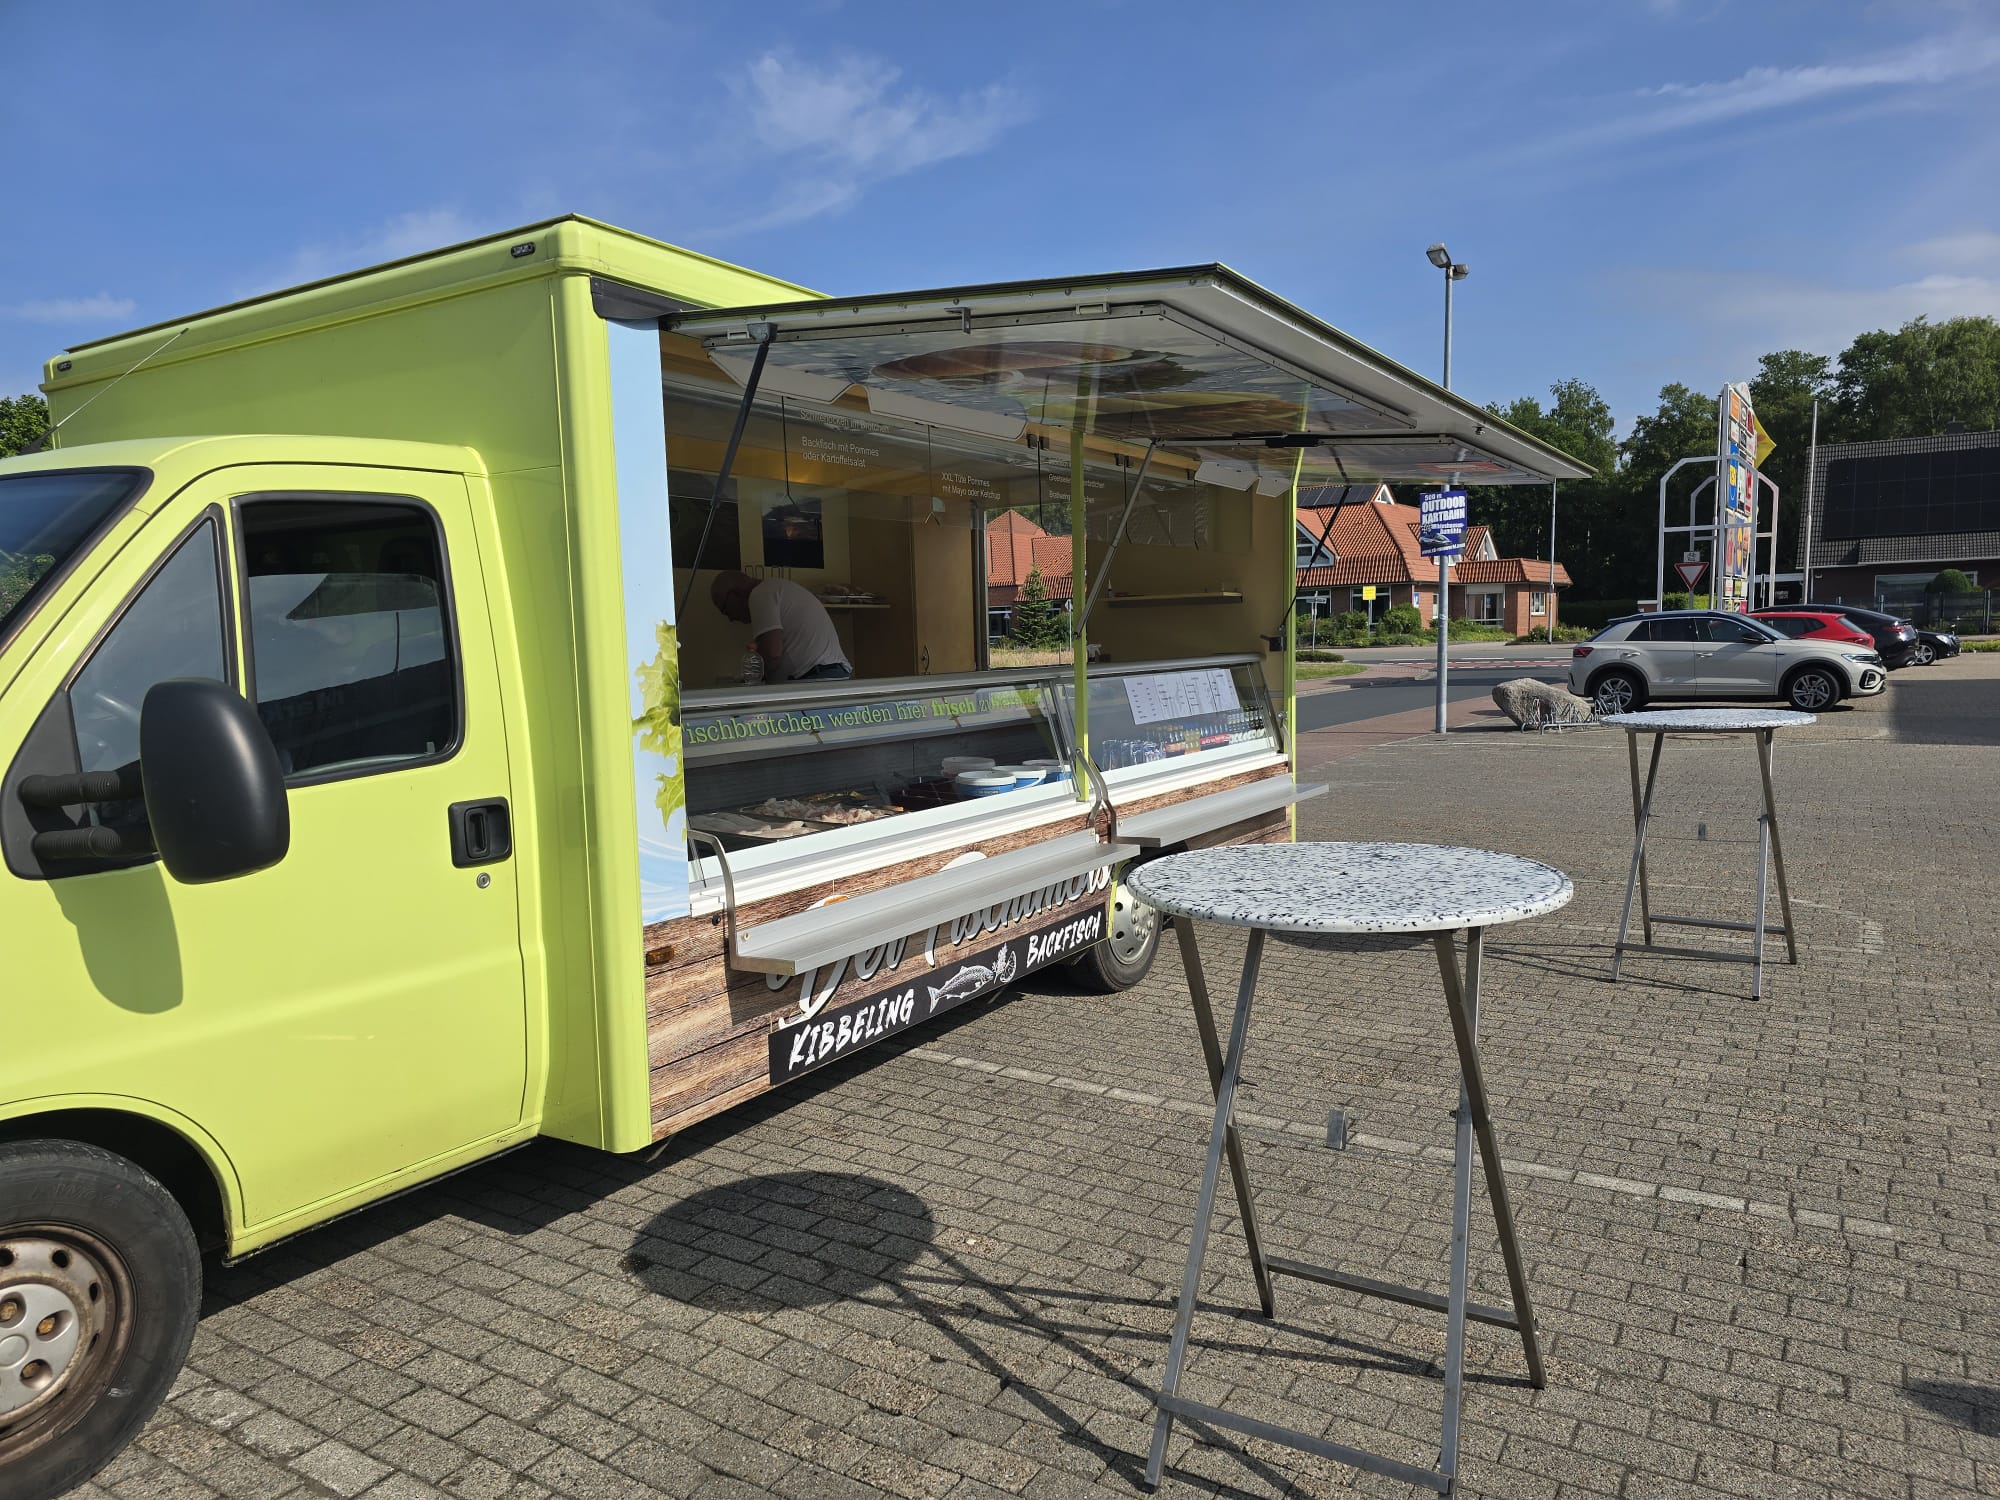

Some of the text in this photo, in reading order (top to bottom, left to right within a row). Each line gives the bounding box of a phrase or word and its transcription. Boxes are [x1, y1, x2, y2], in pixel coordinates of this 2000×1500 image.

[801, 436, 880, 457] Backfisch mit Pommes
[802, 450, 866, 468] oder Kartoffelsalat
[1421, 496, 1466, 513] OUTDOOR
[1421, 507, 1466, 525] KARTBAHN
[681, 711, 823, 744] ischbrötchen
[829, 705, 893, 727] werden
[895, 702, 928, 720] hier
[930, 695, 977, 717] frisch
[787, 911, 1102, 1072] KIBBELING BACKFISCH
